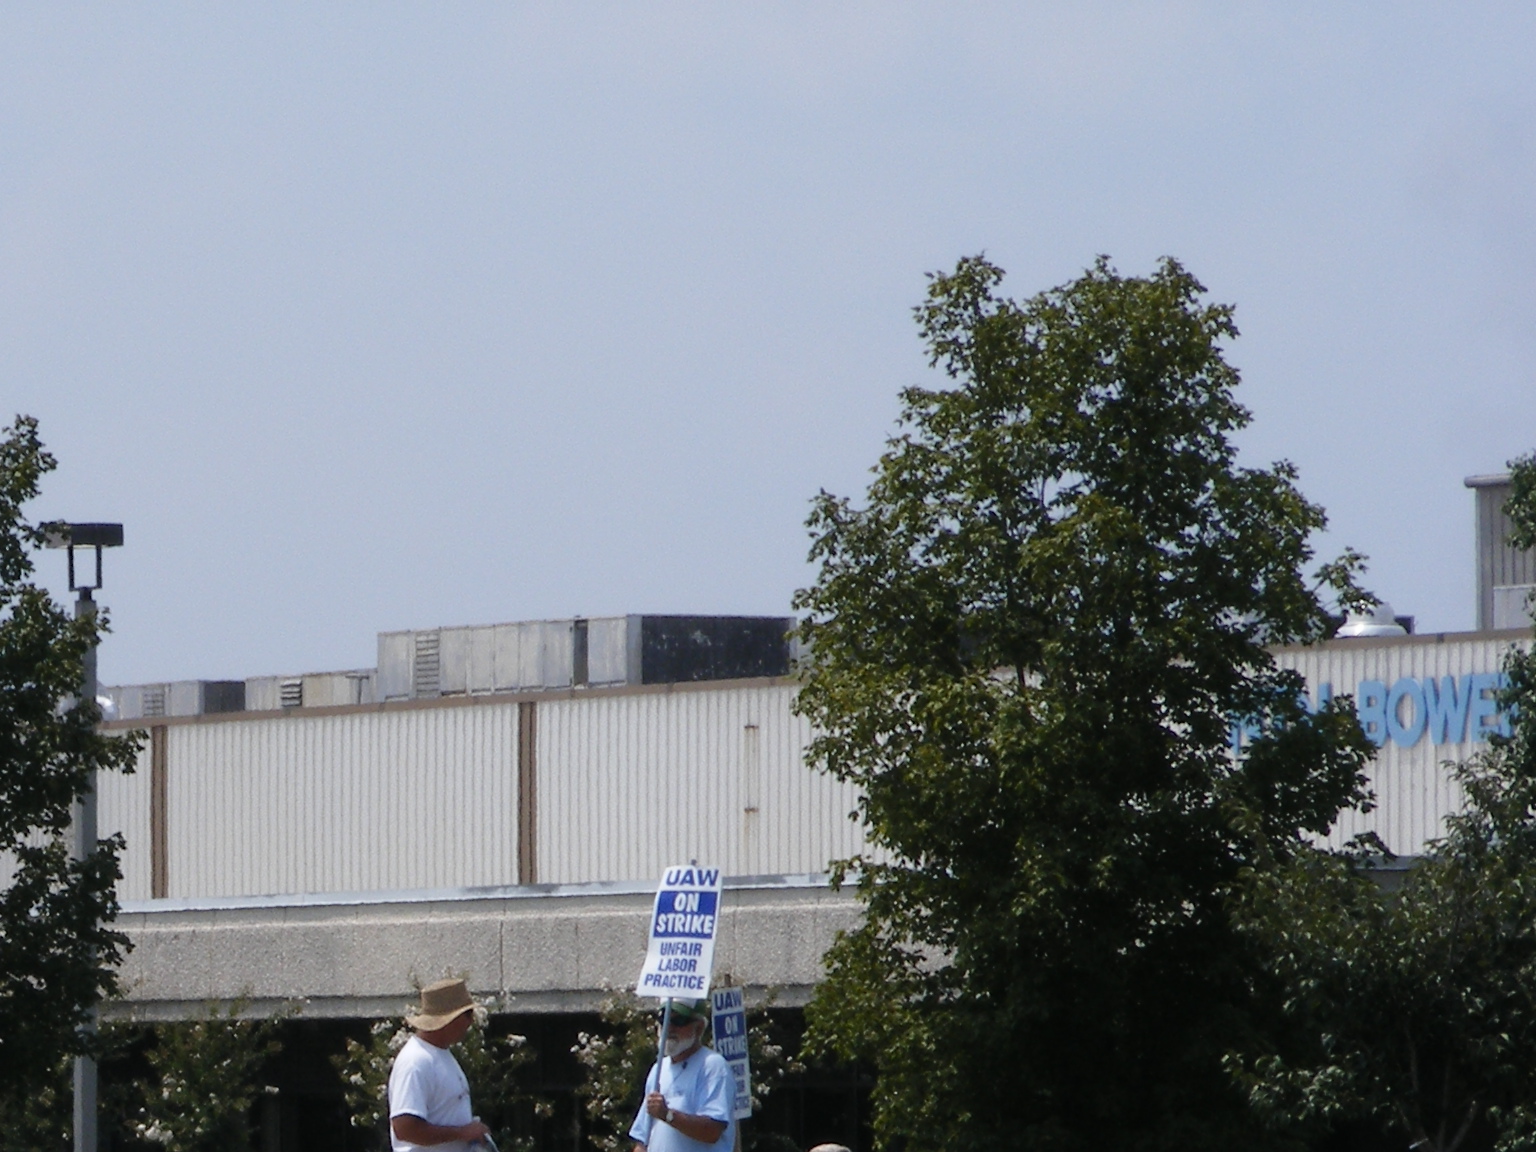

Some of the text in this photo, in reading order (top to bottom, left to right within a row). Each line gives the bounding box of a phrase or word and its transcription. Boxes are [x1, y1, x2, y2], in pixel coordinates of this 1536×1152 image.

[666, 868, 719, 887] UAW
[674, 892, 700, 913] ON
[656, 913, 714, 934] STRIKE
[660, 942, 702, 957] UNFAIR
[658, 958, 697, 972] LABOR
[644, 974, 705, 990] PRACTICE
[714, 990, 742, 1011] UAW
[724, 1015, 739, 1035] ON
[716, 1035, 747, 1057] STRIKE
